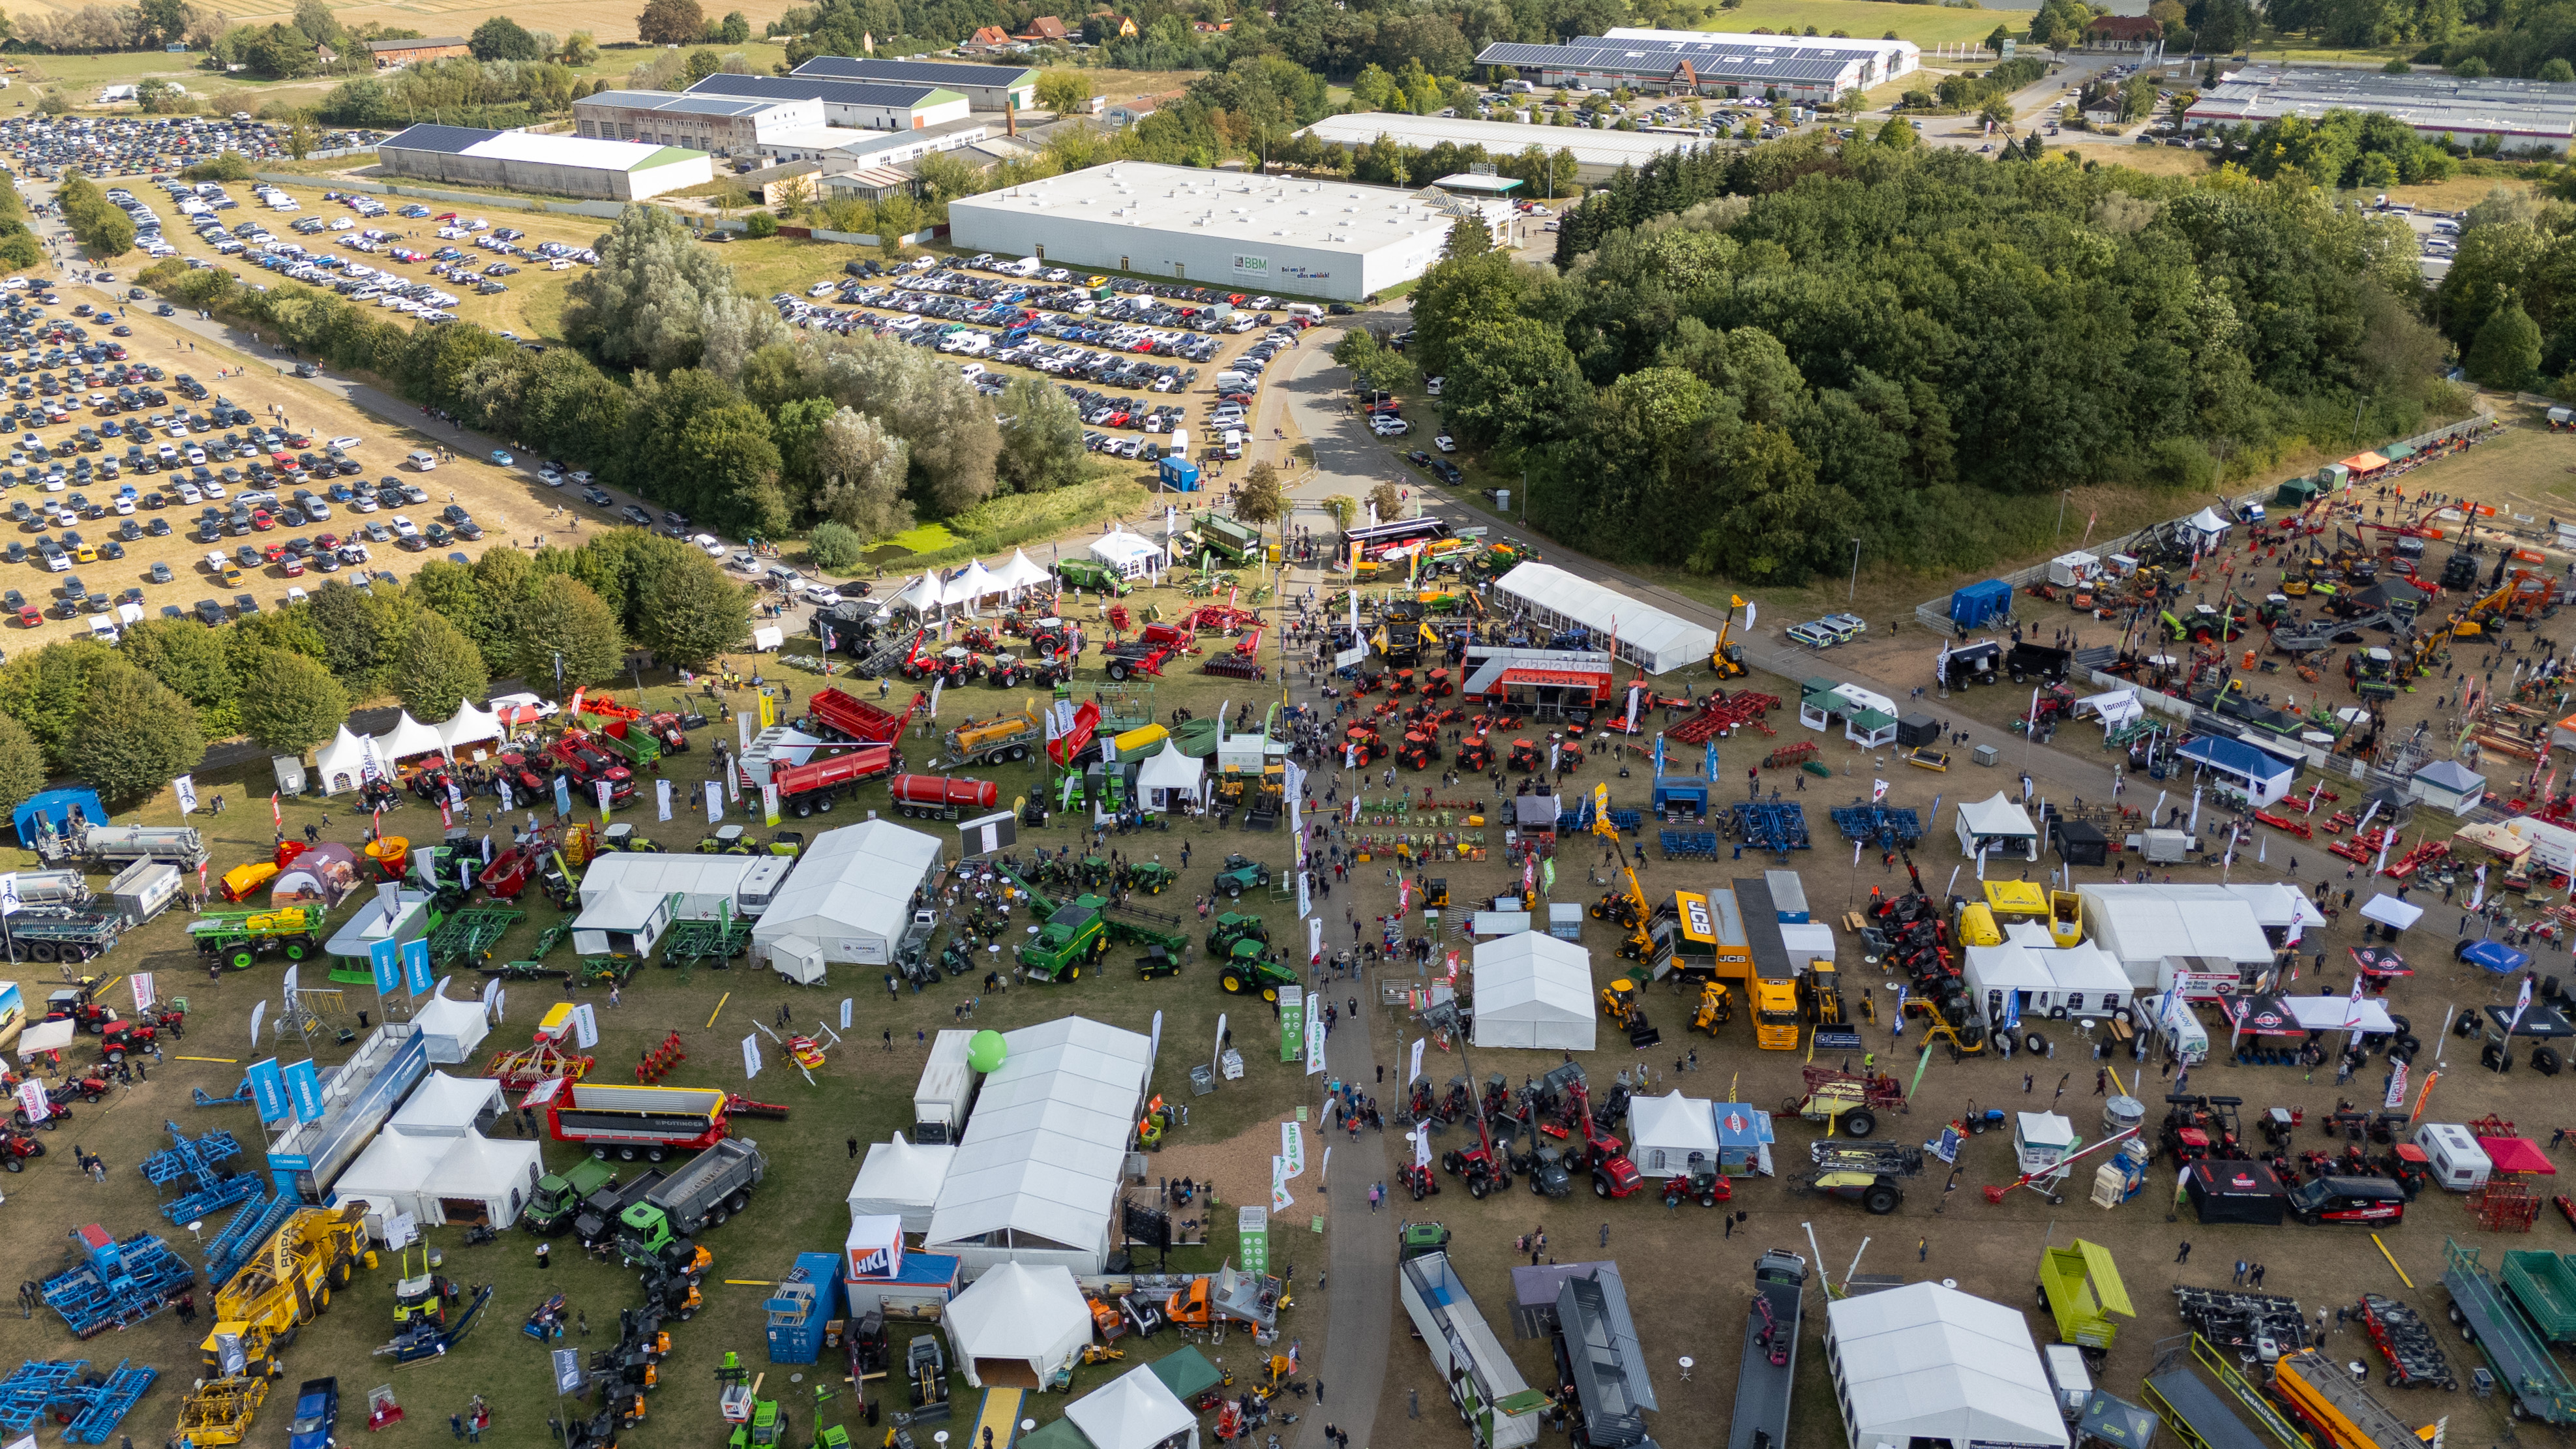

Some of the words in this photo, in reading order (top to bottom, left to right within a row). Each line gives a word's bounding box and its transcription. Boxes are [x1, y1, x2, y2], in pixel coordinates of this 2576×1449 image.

[1245, 257, 1267, 271] BBM
[1513, 674, 1588, 686] Kubota
[363, 754, 374, 779] TITAN
[1687, 900, 1712, 935] JCB
[1718, 955, 1746, 963] JCB
[134, 975, 144, 1000] BELARUS
[404, 1054, 421, 1076] LEMKEN
[22, 1085, 37, 1111] BELARUS
[264, 1080, 278, 1109] LEMKEN
[299, 1079, 314, 1109] LEMKEN
[1289, 1124, 1298, 1159] team
[281, 1227, 292, 1268] ROPA
[856, 1248, 888, 1274] HKL
